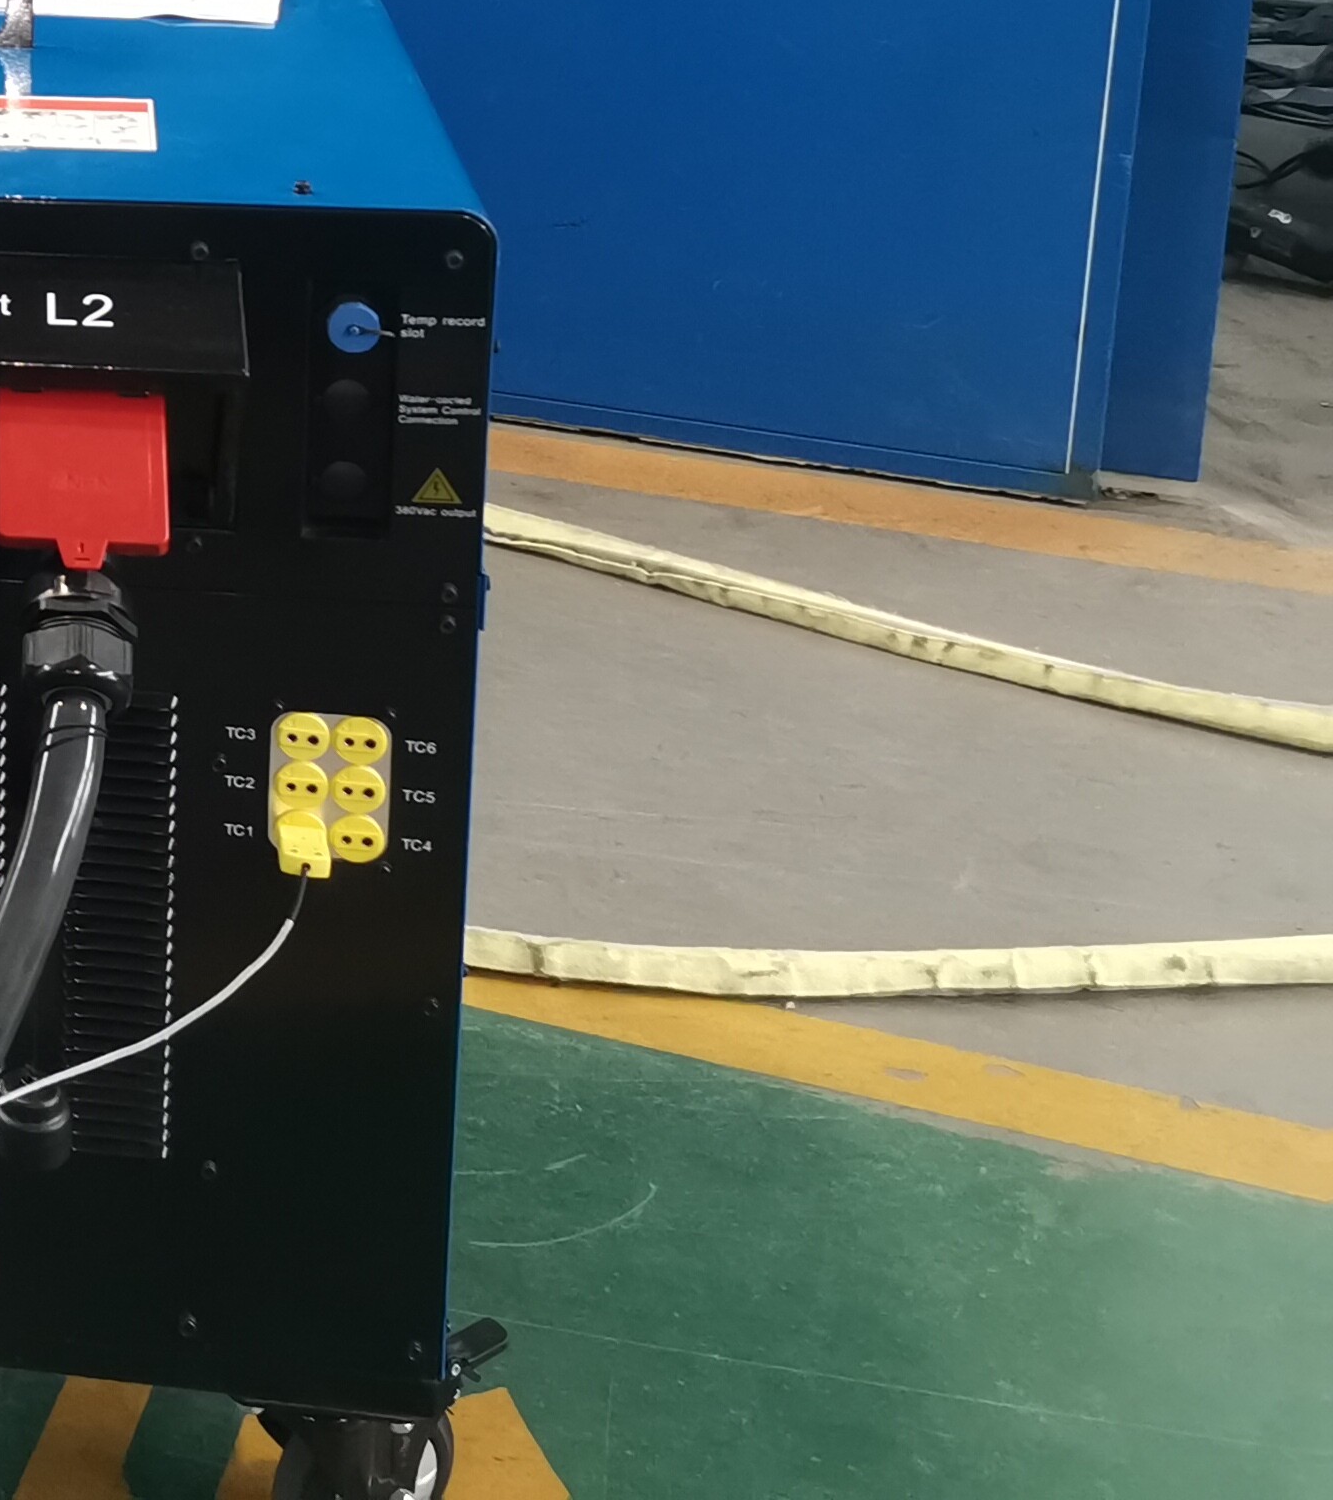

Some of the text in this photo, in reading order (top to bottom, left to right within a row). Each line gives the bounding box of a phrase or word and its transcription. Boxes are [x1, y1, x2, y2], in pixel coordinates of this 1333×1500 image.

[45, 291, 115, 328] L2
[400, 313, 486, 328] Temp record
[400, 327, 426, 339] slot
[398, 404, 439, 415] System
[225, 725, 257, 741] TC3
[404, 739, 438, 755] TC6
[224, 774, 256, 790] TC2
[402, 788, 437, 804] TC5
[223, 822, 254, 838] TC1
[401, 837, 433, 853] TC4
